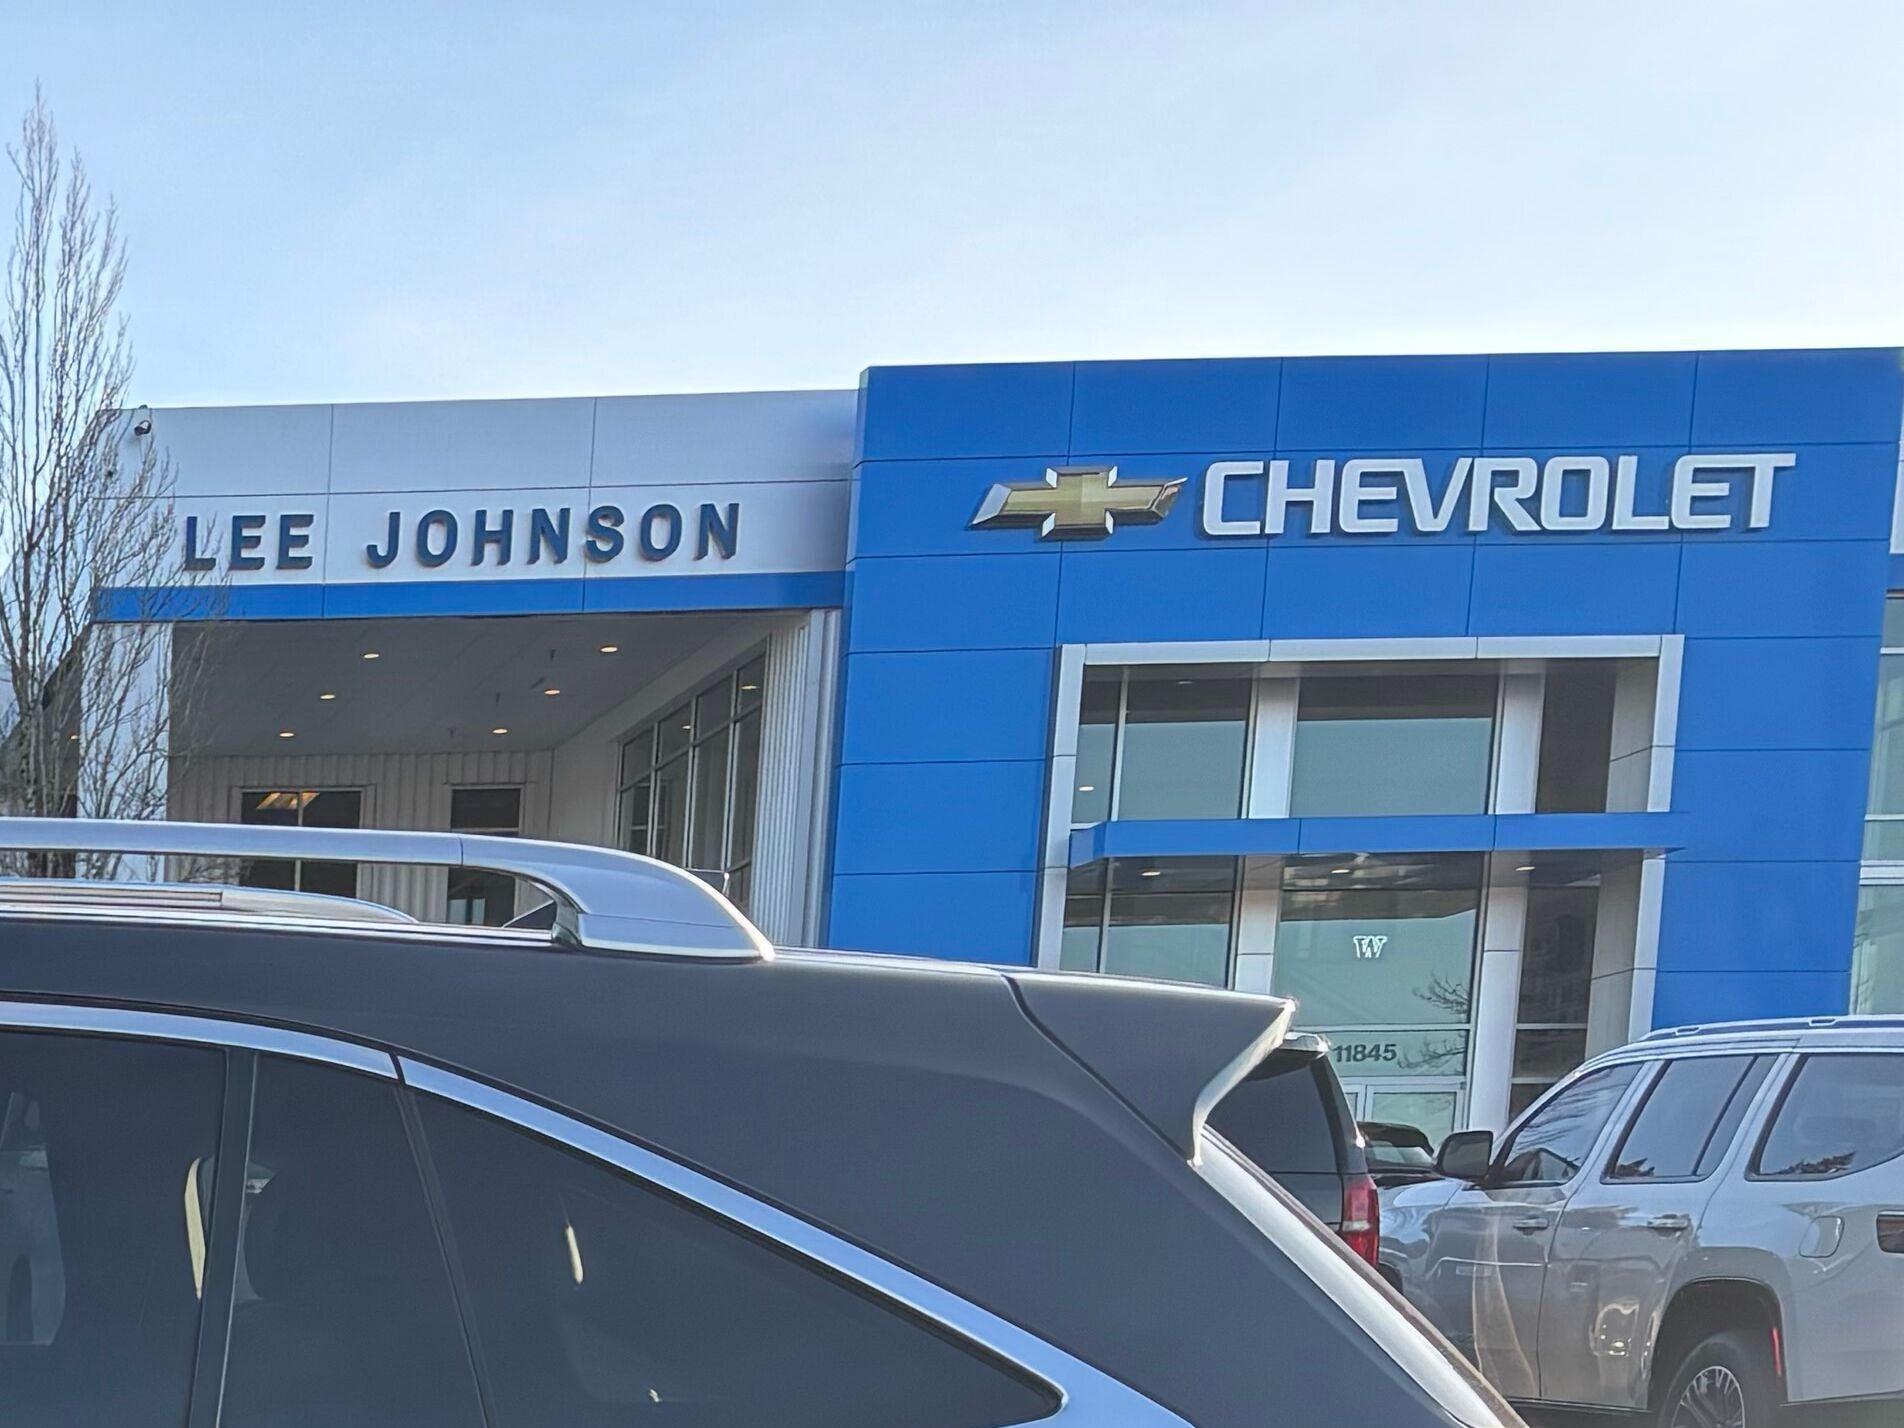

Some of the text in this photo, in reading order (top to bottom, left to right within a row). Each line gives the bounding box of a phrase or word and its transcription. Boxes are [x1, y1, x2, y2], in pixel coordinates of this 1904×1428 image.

[1202, 452, 1797, 536] CHEVROLET
[184, 503, 741, 571] LEE JOHNSON
[1335, 1044, 1397, 1063] 11845
